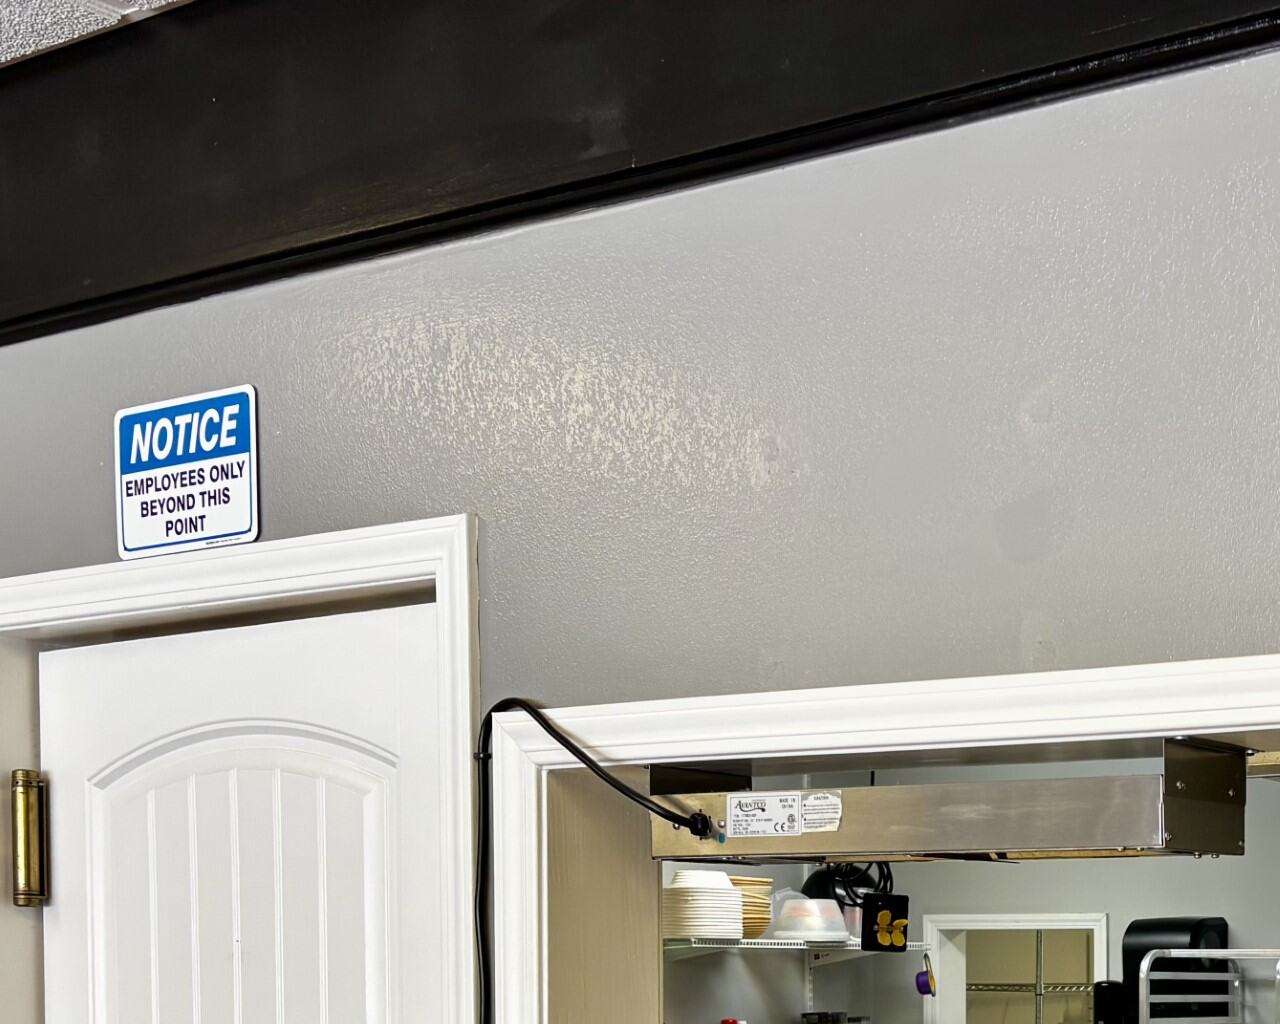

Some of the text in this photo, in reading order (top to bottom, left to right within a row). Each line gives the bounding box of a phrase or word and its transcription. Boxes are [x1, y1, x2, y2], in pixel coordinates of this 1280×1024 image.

[130, 403, 240, 465] NOTICE
[125, 459, 246, 498] EMPLOYEES ONLY
[140, 486, 231, 518] BEYOND THIS
[165, 514, 207, 538] POINT
